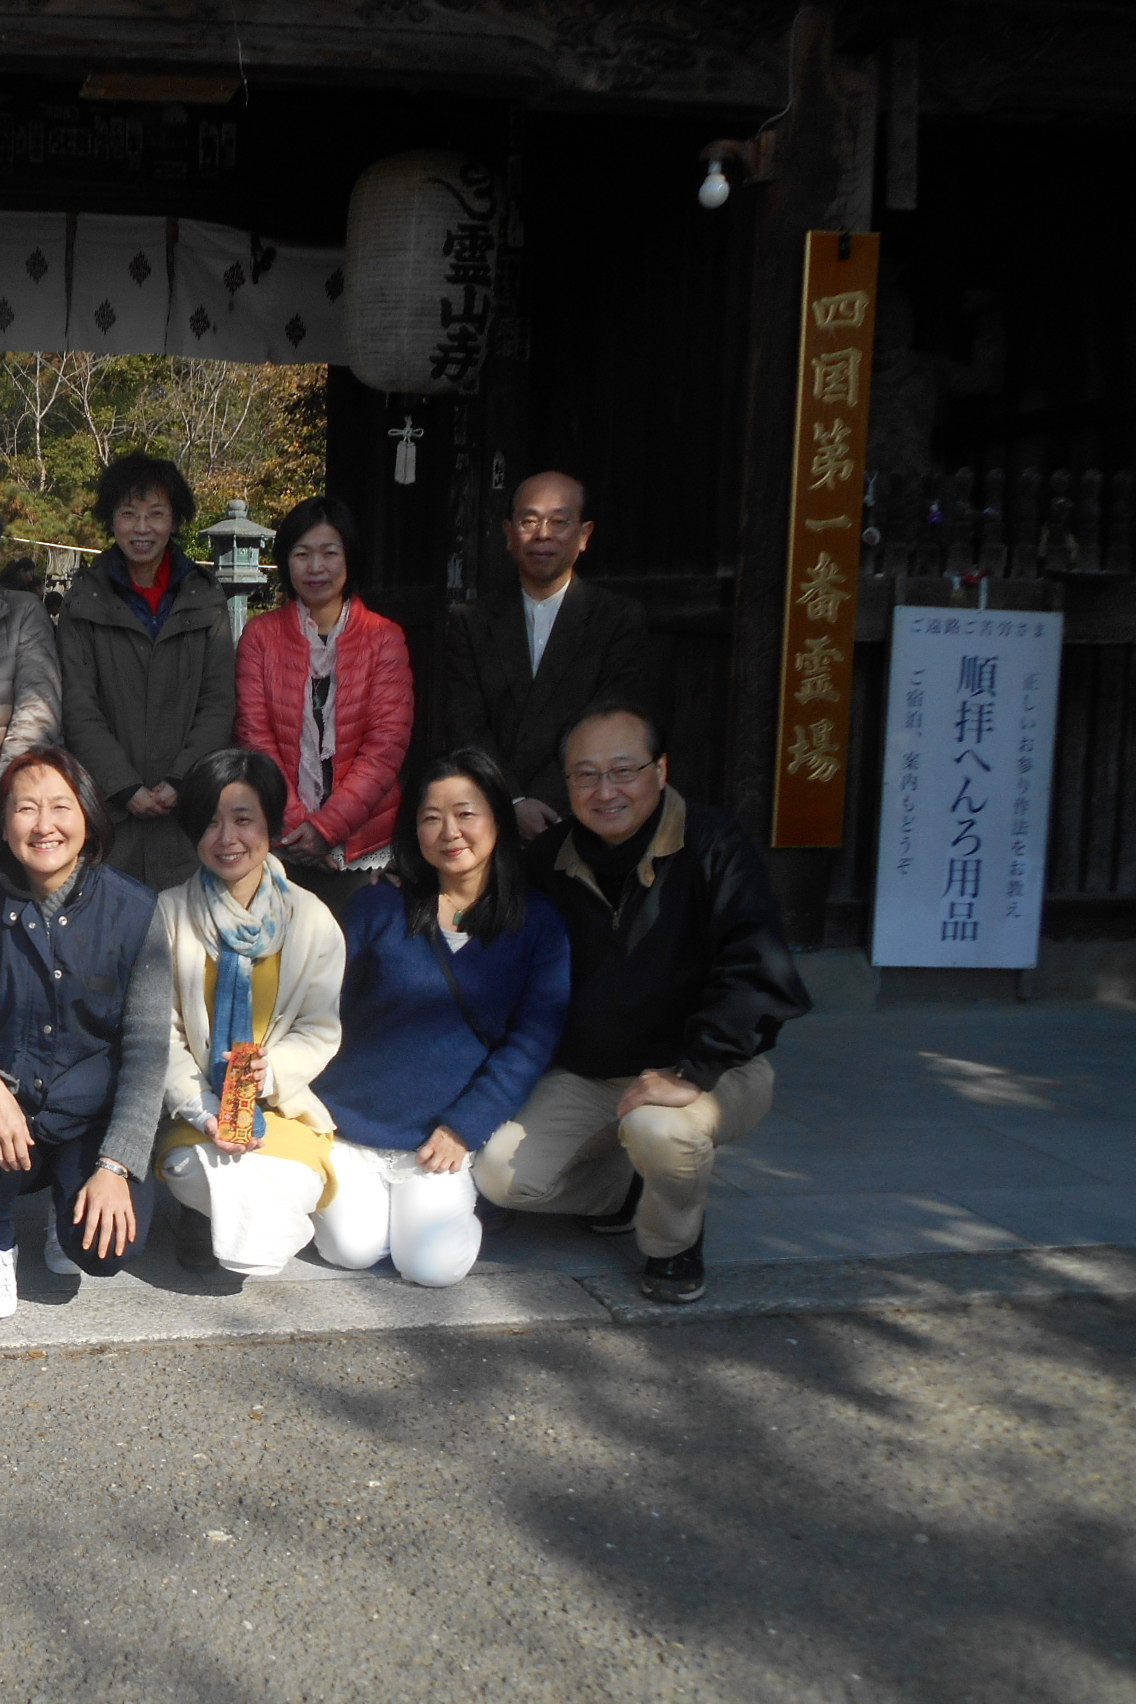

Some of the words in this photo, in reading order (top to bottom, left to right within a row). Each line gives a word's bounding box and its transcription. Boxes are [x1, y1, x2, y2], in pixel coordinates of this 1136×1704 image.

[787, 289, 869, 783] 四国第一番霊場
[940, 654, 999, 942] 順拝へんろ用品
